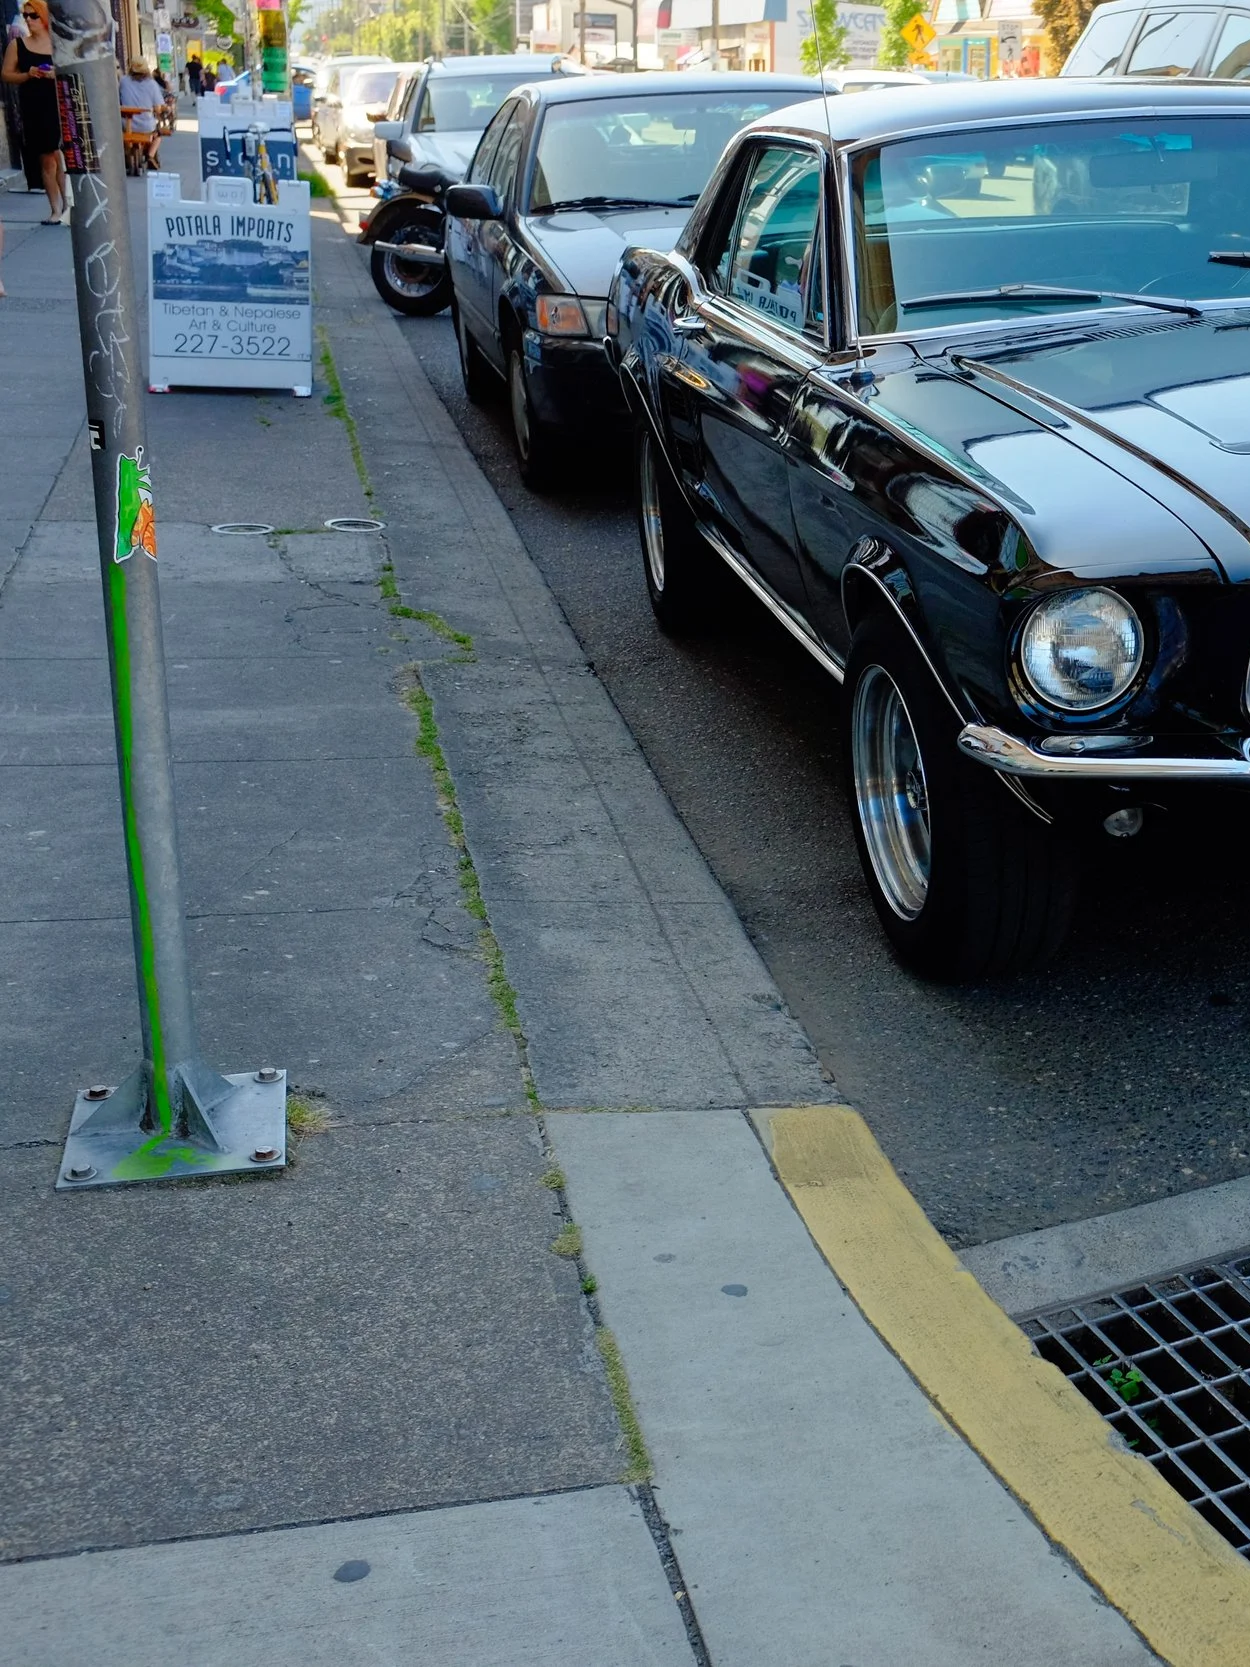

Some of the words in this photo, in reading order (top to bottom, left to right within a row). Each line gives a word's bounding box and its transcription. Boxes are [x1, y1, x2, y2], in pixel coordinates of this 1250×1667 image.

[165, 215, 222, 238] POTALA
[231, 215, 294, 243] IMPORTS
[162, 302, 215, 317] Tibetan
[219, 305, 230, 318] &
[234, 305, 301, 320] Nepalese
[188, 318, 207, 331] Art
[211, 319, 223, 332] &
[226, 320, 277, 333] Culture
[174, 333, 291, 357] 227-3522
